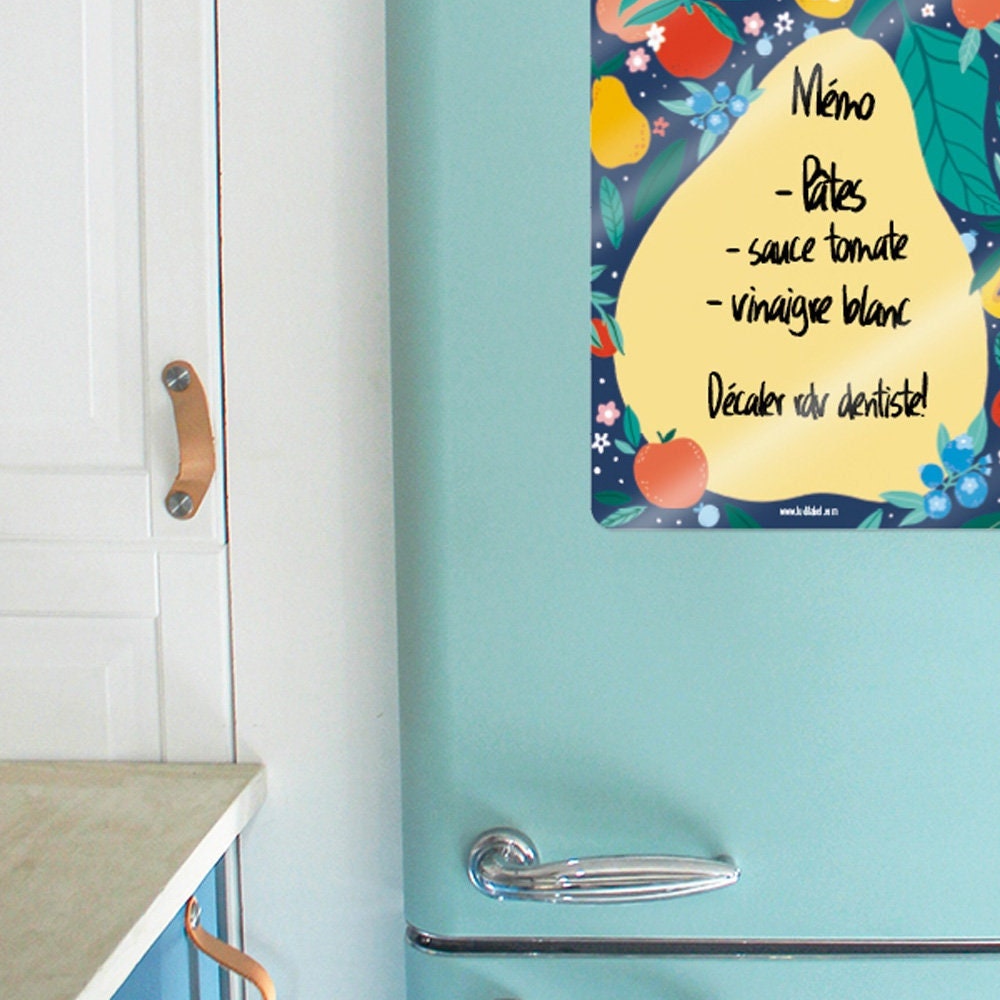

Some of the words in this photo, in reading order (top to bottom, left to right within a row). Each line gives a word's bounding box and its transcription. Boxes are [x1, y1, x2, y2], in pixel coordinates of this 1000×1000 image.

[792, 63, 876, 121] Mémo
[803, 155, 867, 214] Pâtes
[748, 236, 816, 266] sauce
[824, 220, 909, 264] tomate
[732, 286, 833, 337] vinaigre
[842, 284, 912, 329] blanc
[707, 371, 786, 419] Décaler
[793, 381, 830, 420] rdv
[837, 371, 929, 420] dentiste!
